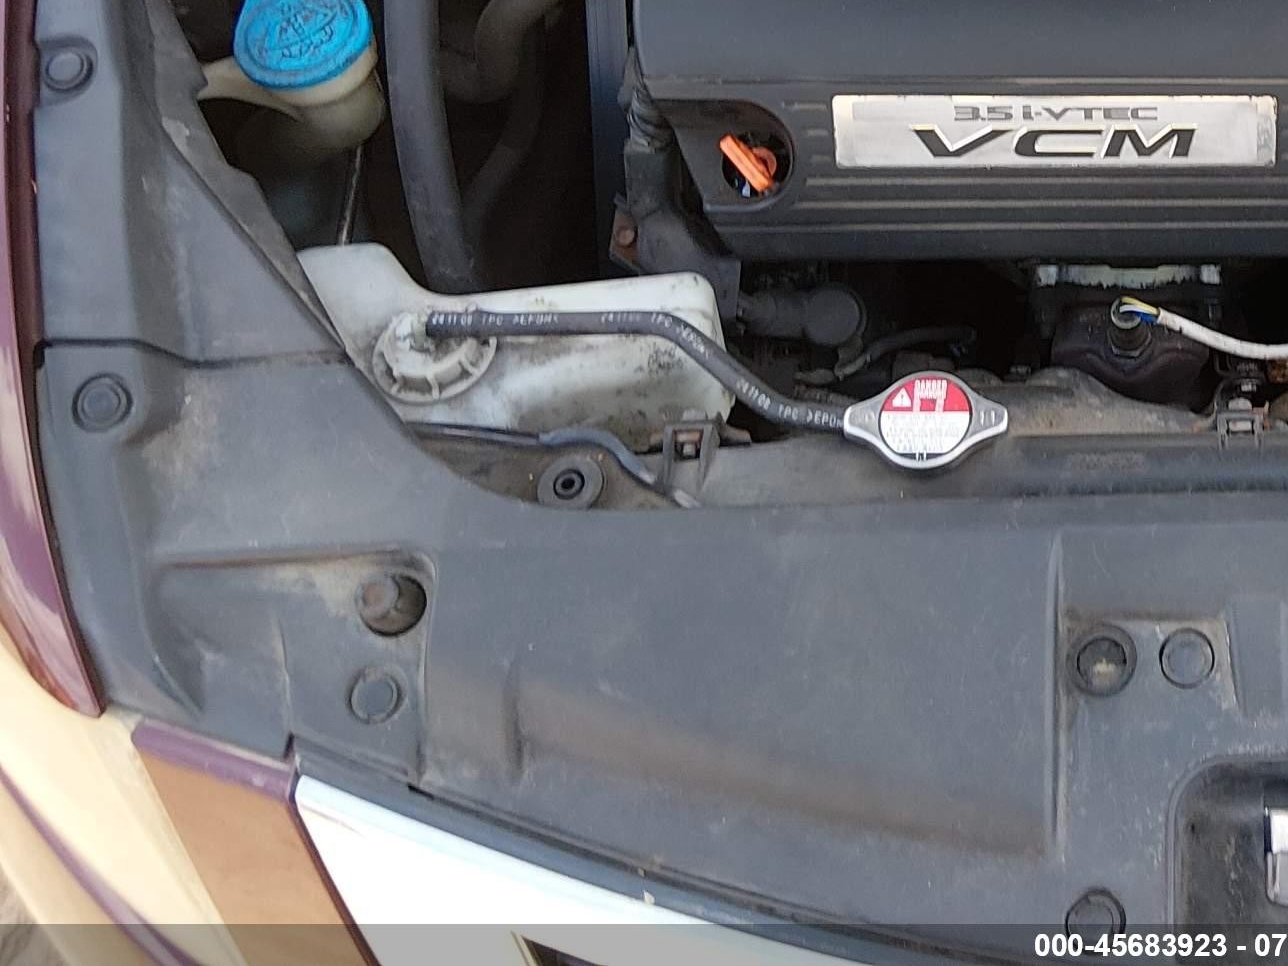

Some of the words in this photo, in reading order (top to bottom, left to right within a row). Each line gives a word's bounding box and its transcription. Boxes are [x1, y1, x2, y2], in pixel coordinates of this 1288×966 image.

[953, 105, 1013, 122] 3.5
[1022, 105, 1158, 122] i-VTEC
[911, 123, 1198, 158] VCM
